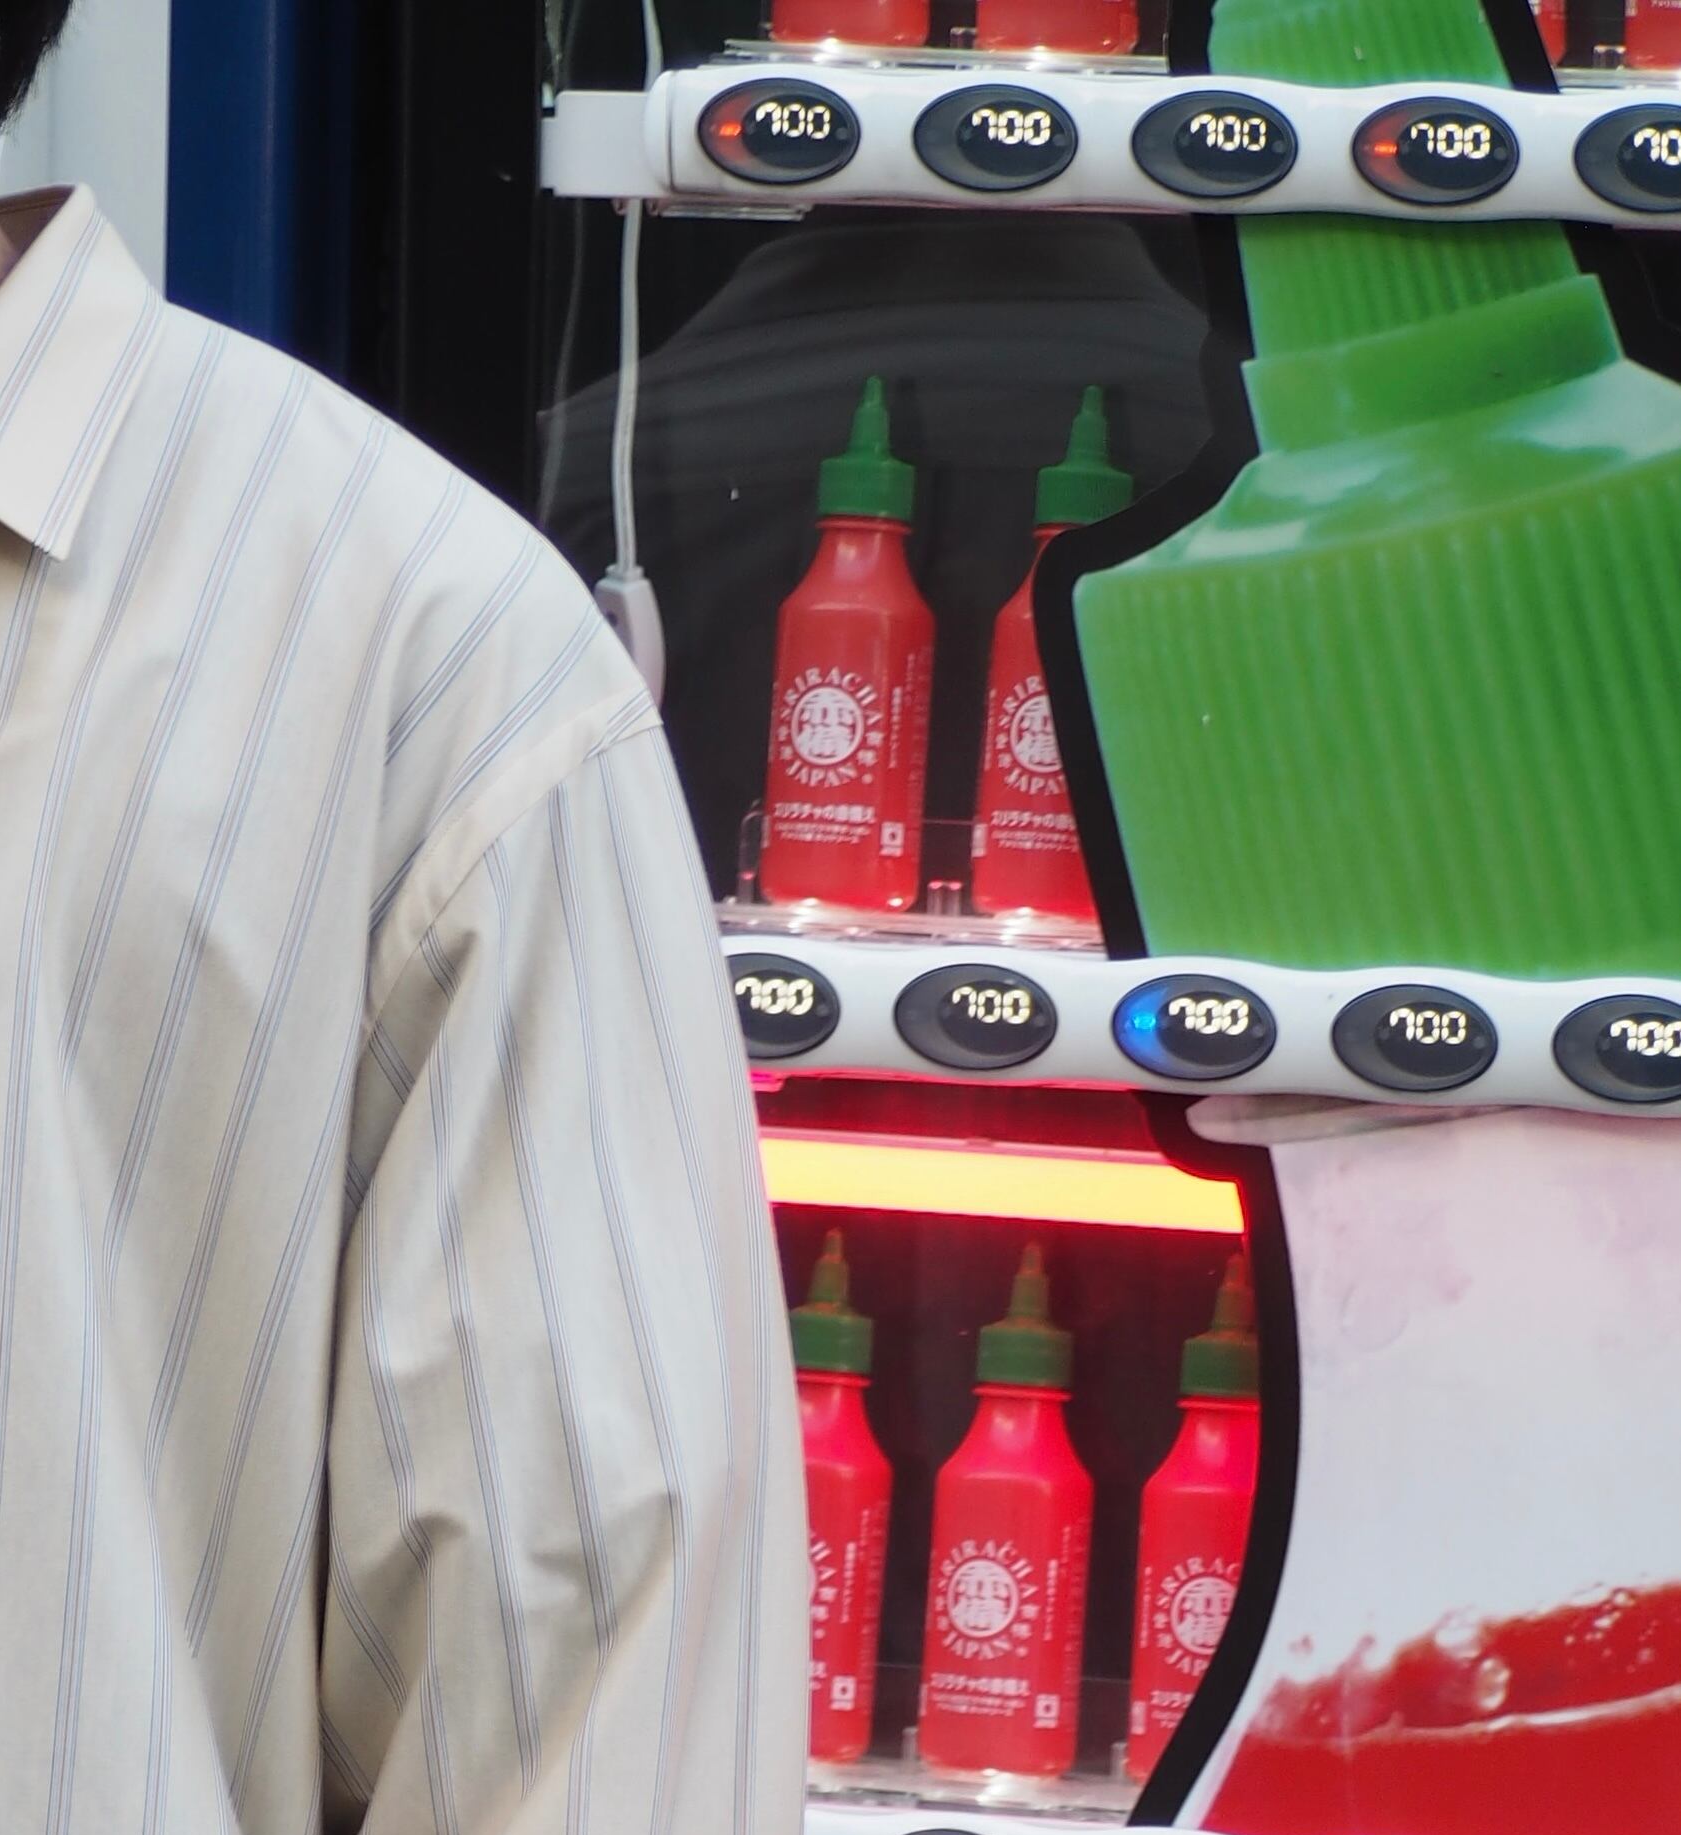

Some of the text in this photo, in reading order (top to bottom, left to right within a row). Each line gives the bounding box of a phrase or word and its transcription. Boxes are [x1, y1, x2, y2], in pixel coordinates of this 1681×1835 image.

[755, 102, 831, 140] 700
[971, 108, 1051, 146] 700
[1190, 114, 1267, 152] 700
[1410, 122, 1491, 160] 700
[999, 675, 1046, 729] SRIR
[785, 759, 858, 788] JAPAN
[1003, 767, 1066, 796] JAPA
[735, 976, 814, 1016] 700
[951, 985, 1031, 1025] 700
[1168, 997, 1249, 1036] 700
[1389, 1007, 1467, 1045] 700
[1609, 1019, 1681, 1058] 700
[1155, 1556, 1241, 1609] SRIRAC
[942, 1631, 1013, 1661] JAPAN
[1164, 1648, 1211, 1677] JAP
